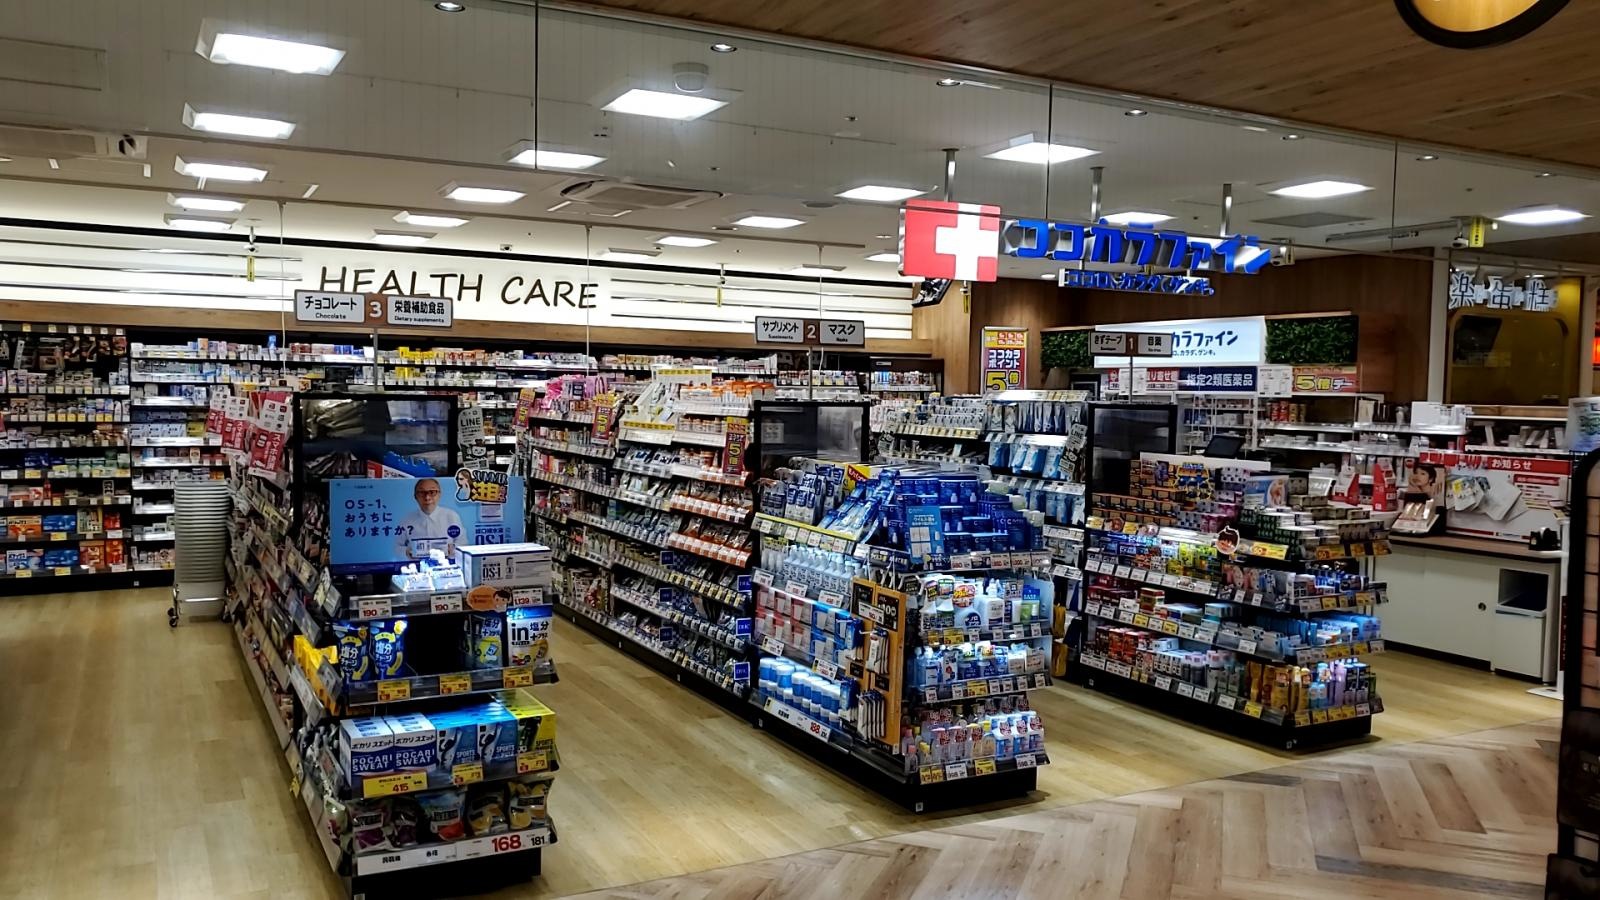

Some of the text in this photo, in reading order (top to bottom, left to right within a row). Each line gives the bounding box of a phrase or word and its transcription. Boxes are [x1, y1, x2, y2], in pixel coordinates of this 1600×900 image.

[1012, 217, 1271, 274] ココカラファイン
[319, 266, 599, 309] HEALTH CARE
[304, 295, 357, 311] チョコレート
[394, 300, 445, 315] 栄養補助食品
[369, 301, 382, 318] 3
[315, 312, 347, 320] Chocolate
[762, 320, 799, 333] サプリメント
[806, 324, 817, 339] 2
[828, 324, 856, 336] マスク
[1128, 337, 1134, 350] 1
[988, 349, 1021, 359] ココカラ
[988, 359, 1020, 369] ポイント
[460, 418, 482, 427] LINE
[1491, 459, 1533, 470] お知らせ
[344, 511, 393, 523] おうちに
[362, 608, 377, 617] 190
[434, 603, 449, 611] 190
[530, 621, 549, 632] 塩分
[511, 623, 529, 642] in
[352, 738, 394, 750] ポカリスエット
[395, 734, 435, 745] ポカリスエット
[456, 749, 475, 759] SPORTS
[496, 744, 515, 753] SPORTS
[352, 753, 393, 766] POCARI
[395, 749, 435, 760] POCARI
[395, 756, 432, 767] SWEAT
[352, 762, 390, 773] SWEAT
[392, 783, 409, 792] 415
[491, 834, 522, 852] 168
[531, 836, 545, 846] 181
